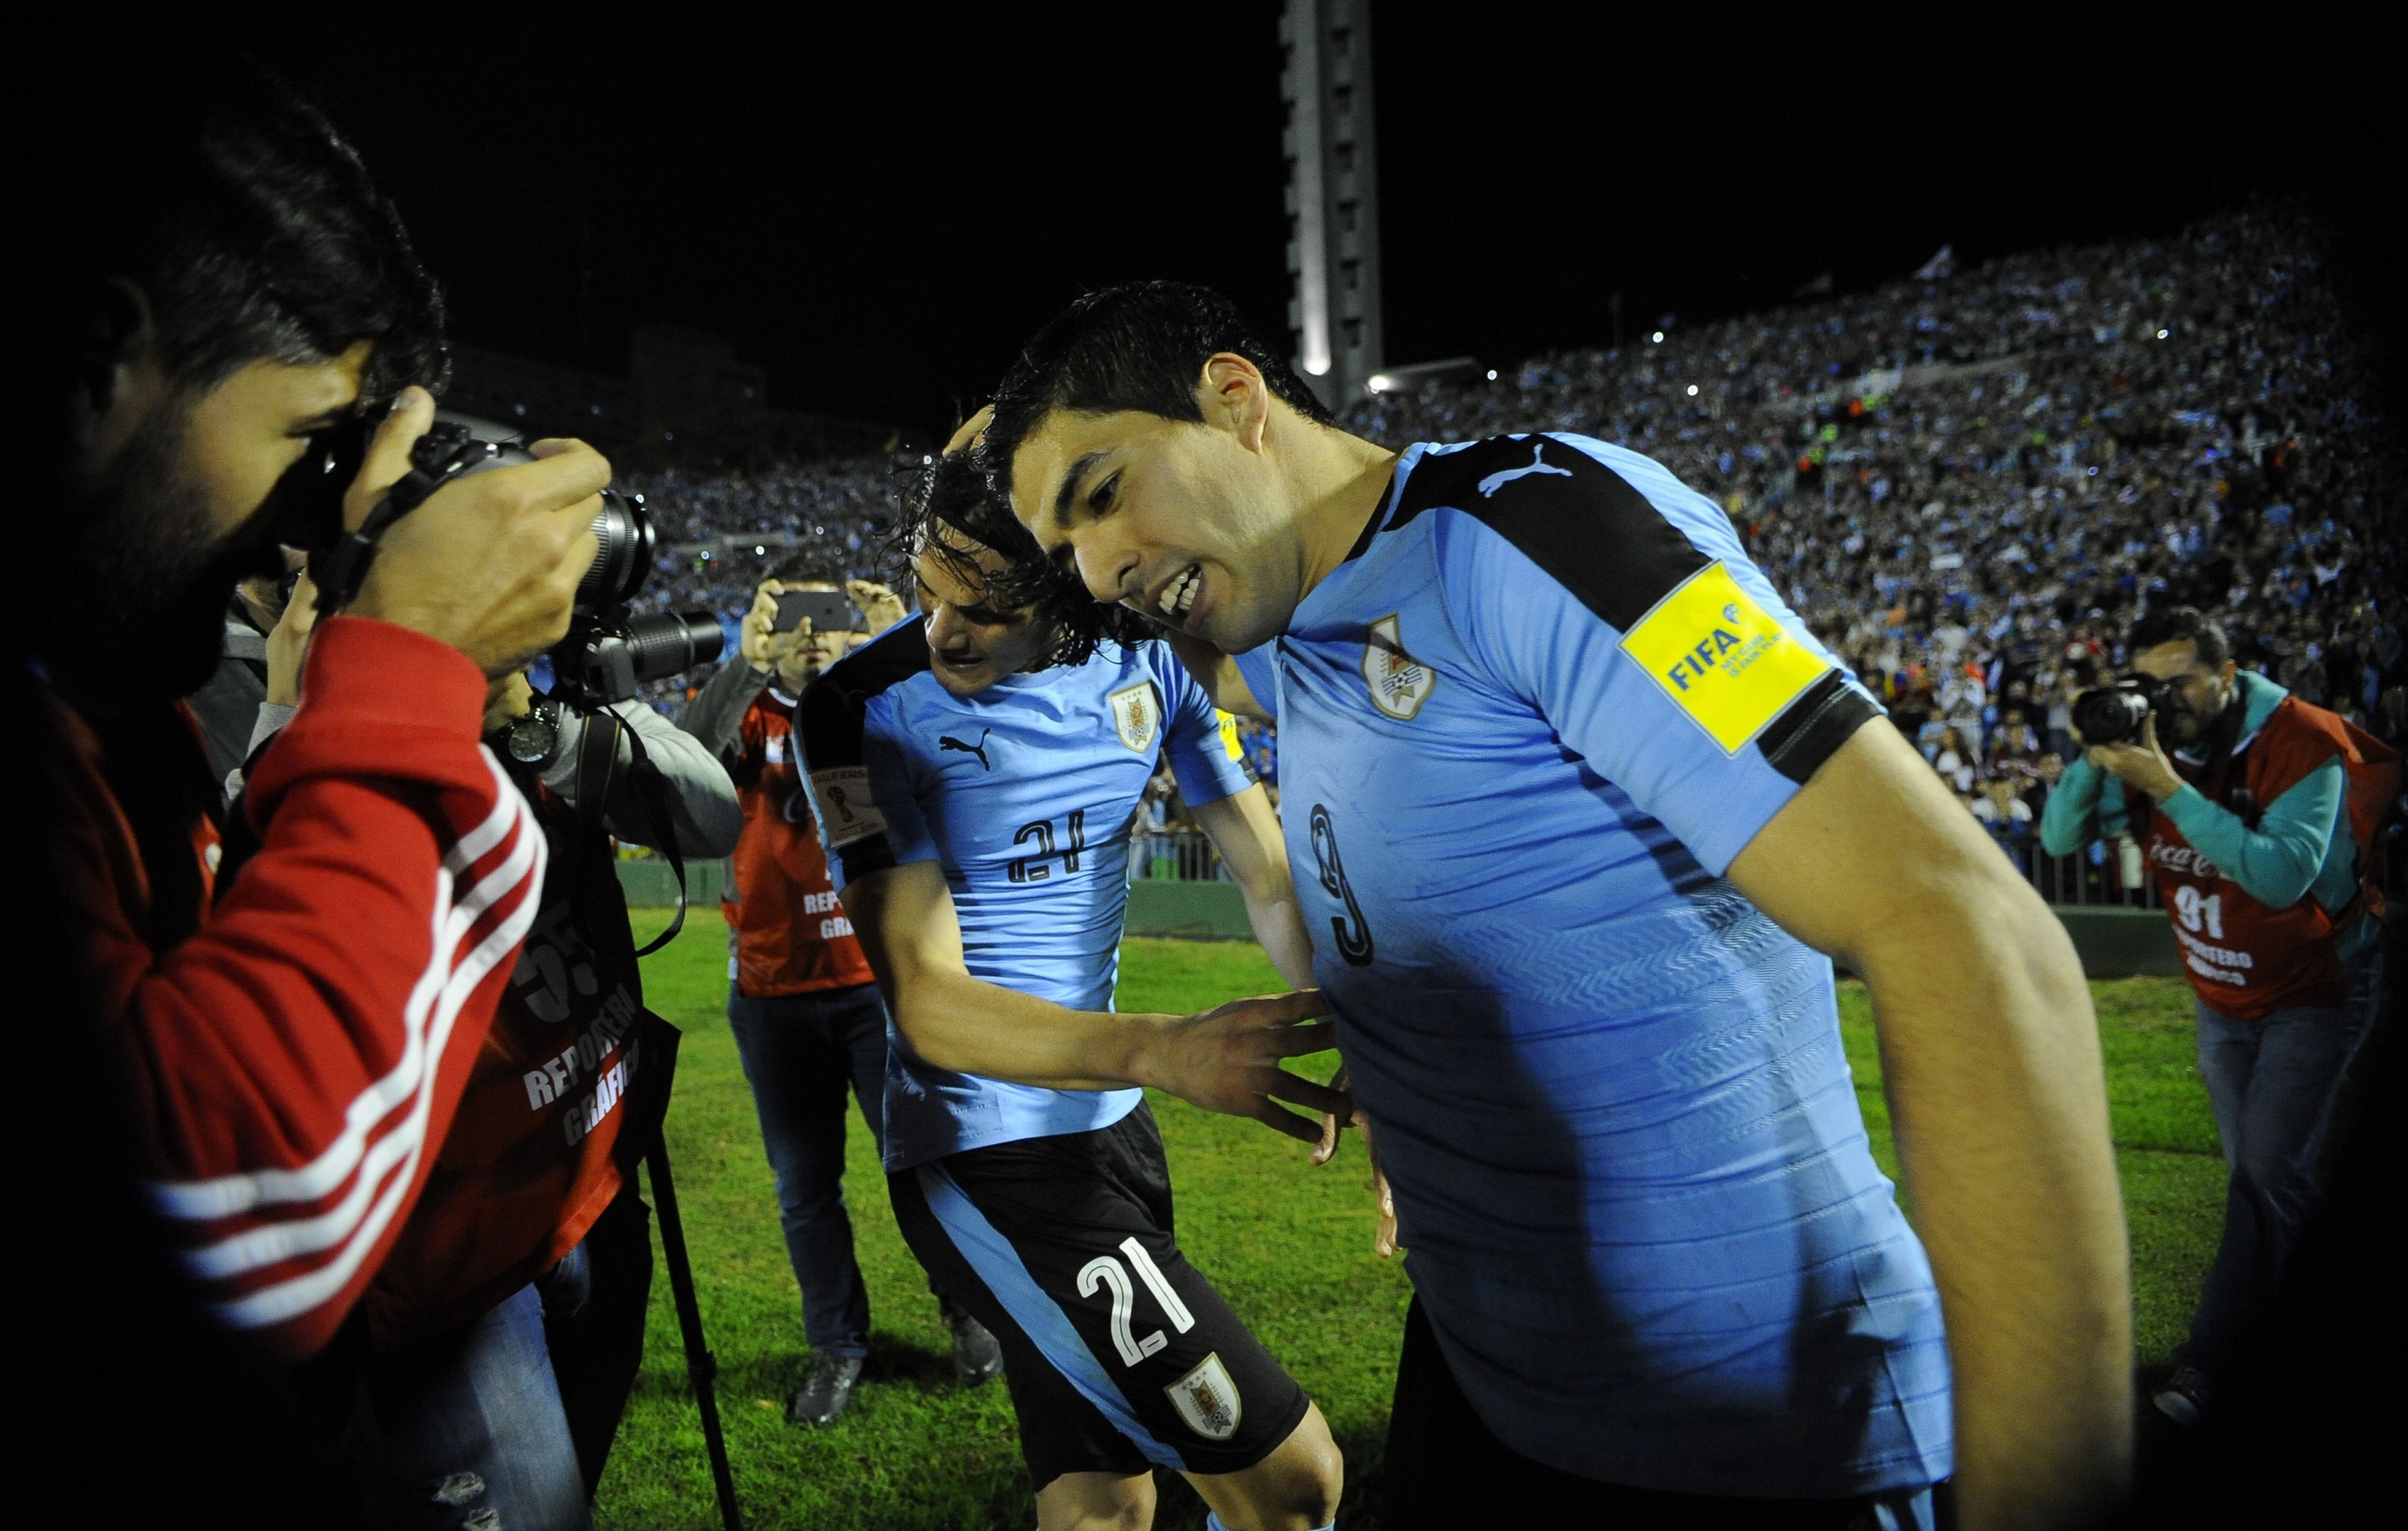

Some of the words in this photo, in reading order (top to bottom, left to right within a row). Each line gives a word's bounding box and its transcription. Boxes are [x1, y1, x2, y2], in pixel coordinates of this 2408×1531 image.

[1668, 628, 1741, 692] FIFA
[811, 770, 866, 784] UALIFIERS
[1007, 810, 1084, 883] 21
[1310, 803, 1373, 966] 9
[2174, 885, 2224, 940] 91
[1076, 1237, 1195, 1367] 21
